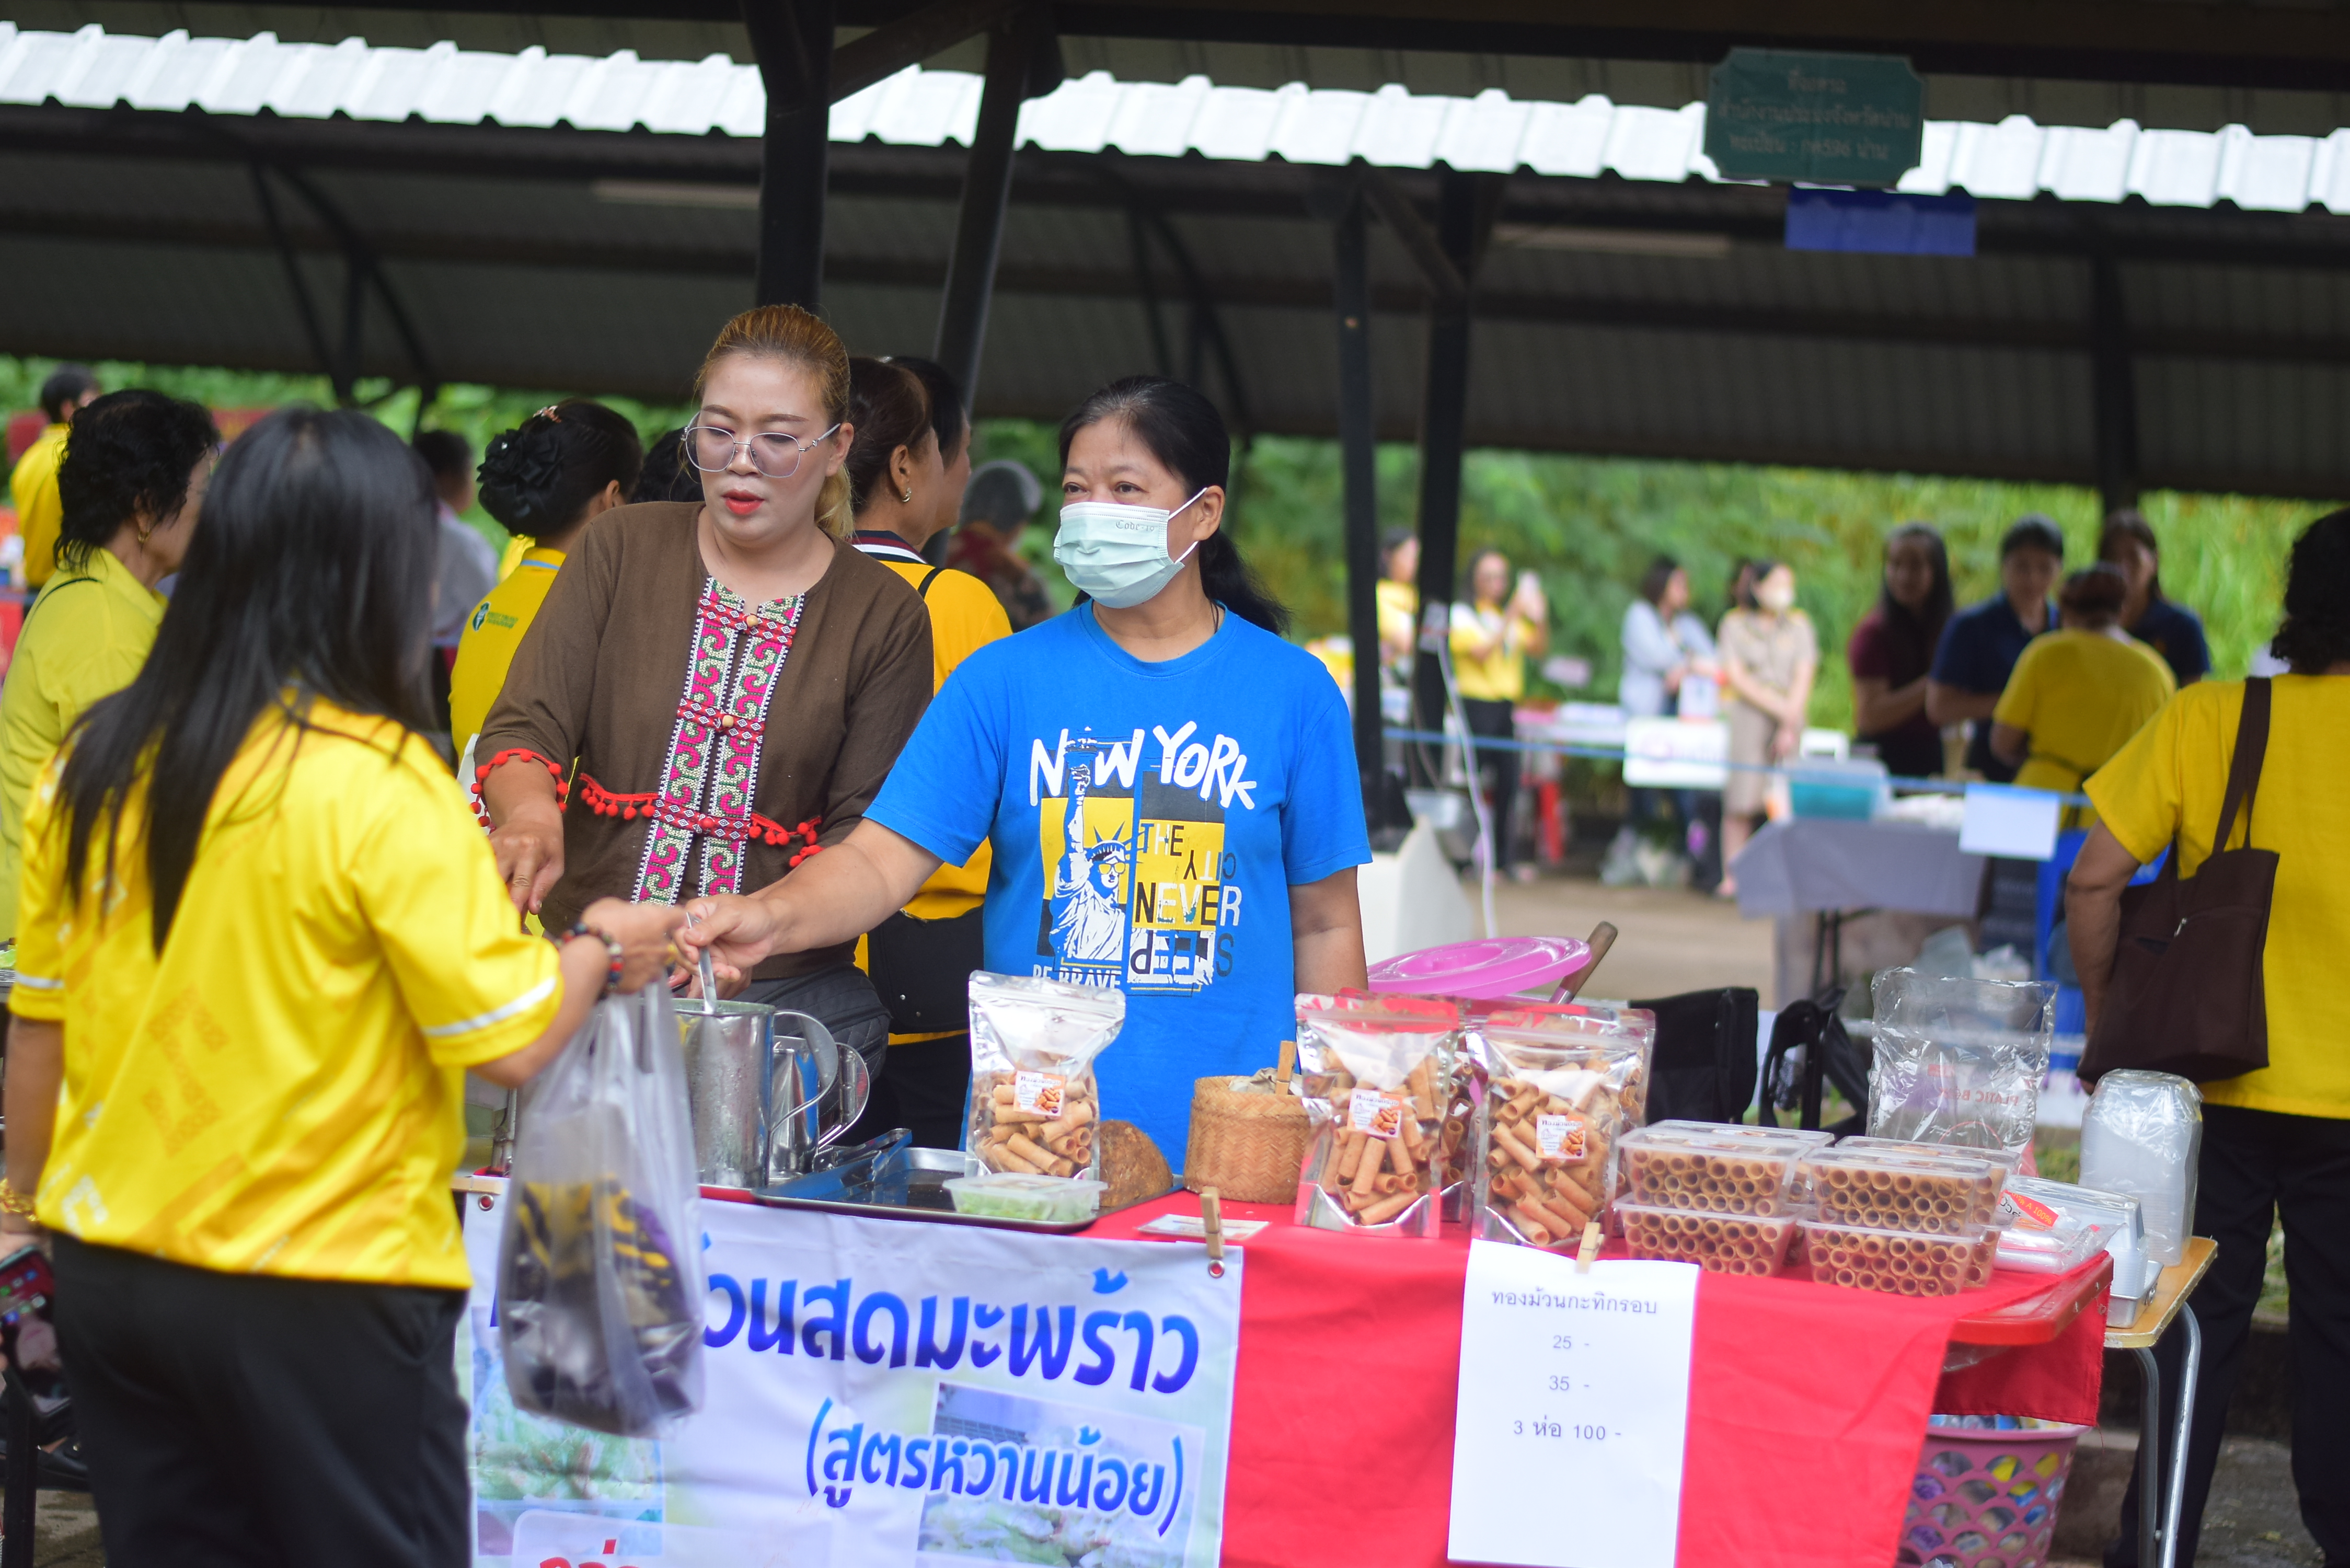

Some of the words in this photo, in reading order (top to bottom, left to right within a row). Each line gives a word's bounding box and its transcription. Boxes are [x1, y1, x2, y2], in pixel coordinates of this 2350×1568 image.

[1030, 729, 1145, 806] NW
[1153, 721, 1257, 810] YORK
[1141, 823, 1184, 856] THE
[1135, 882, 1242, 926] NEVER
[2033, 1207, 2052, 1225] 100%
[702, 1232, 1199, 1393] วนสดมะพร้าว
[1492, 1286, 1657, 1315] ทองม้วนกะทิกรอบ
[1553, 1335, 1572, 1349] 25
[1549, 1375, 1570, 1391] 35
[1514, 1420, 1523, 1435] 3
[1533, 1414, 1561, 1437] ห่อ
[1574, 1424, 1606, 1440] 100
[807, 1398, 1184, 1537] (สูตรหวานน้อย)
